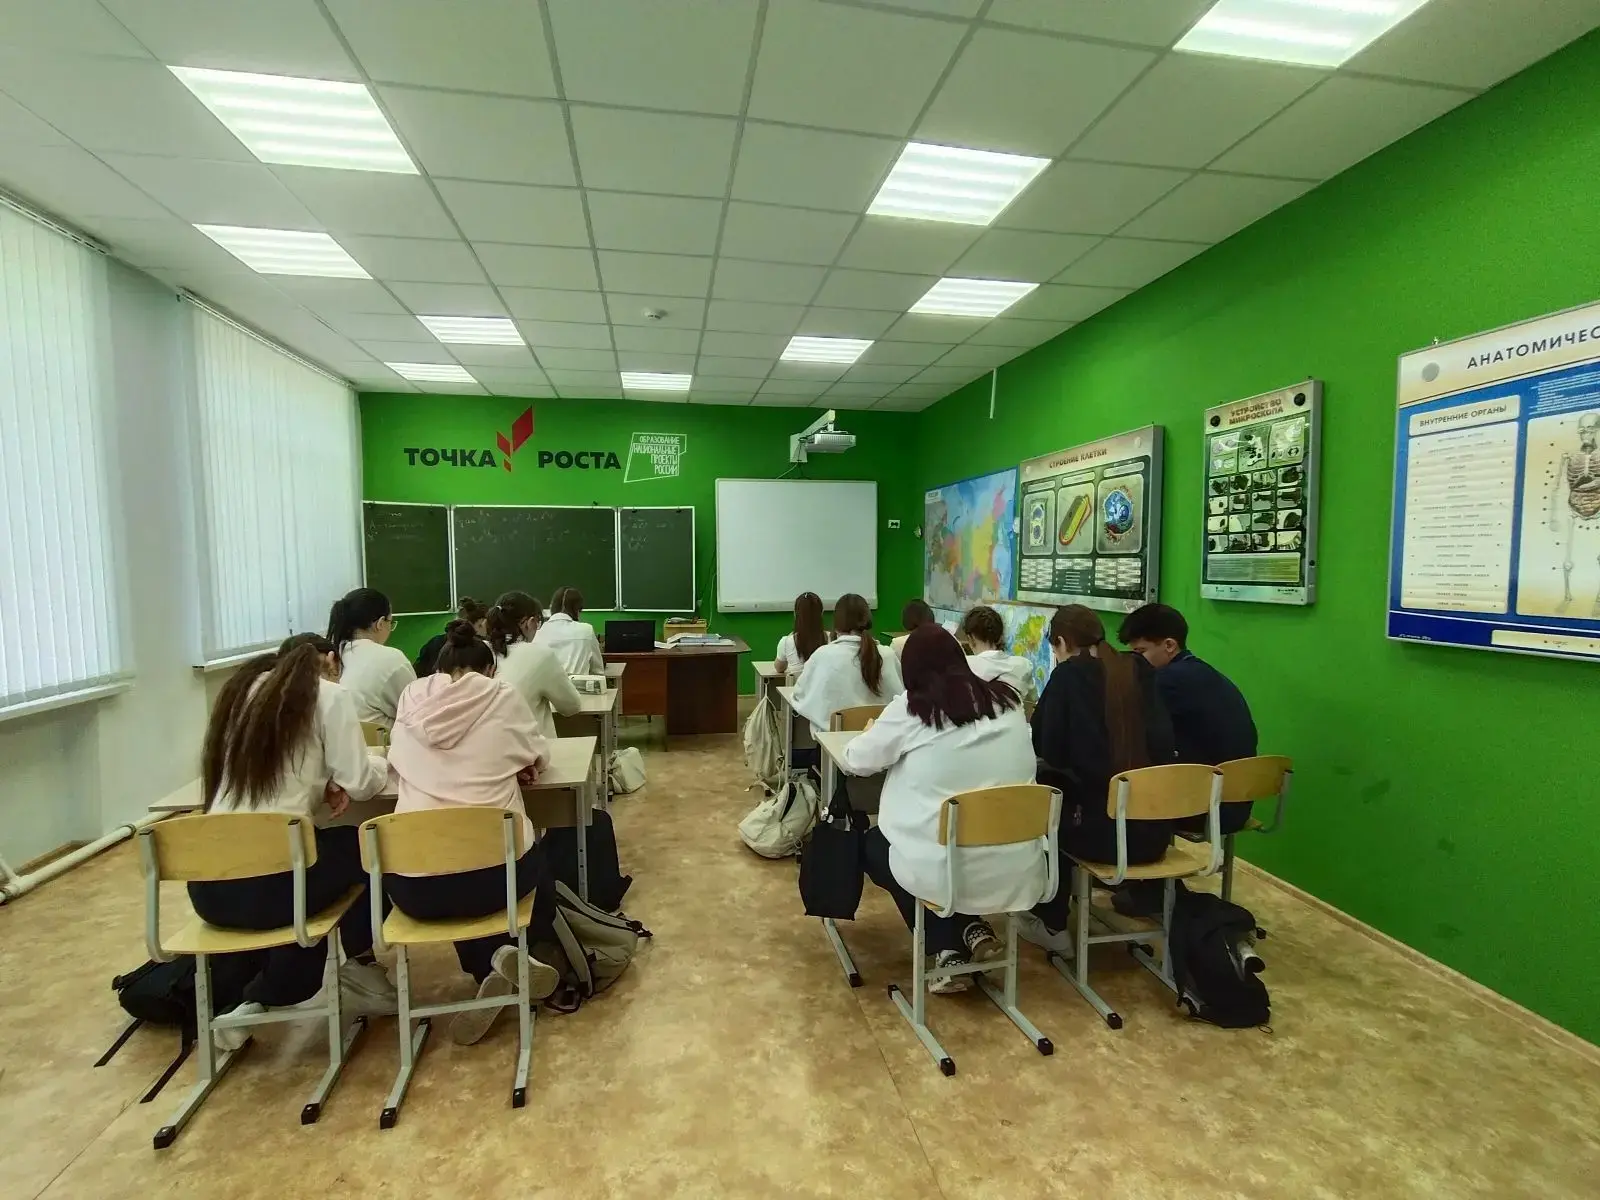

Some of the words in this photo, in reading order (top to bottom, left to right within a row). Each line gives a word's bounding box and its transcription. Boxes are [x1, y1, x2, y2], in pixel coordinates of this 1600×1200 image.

[1229, 407, 1283, 425] МИКРОСКОПА
[1419, 412, 1468, 427] ВНУТРЕННИЕ
[1470, 404, 1507, 418] ОРГАНЫ
[639, 435, 680, 445] ОБРАЗОВАНИЕ
[633, 444, 678, 455] НАЦИОНАЛЬНЫЕ
[1081, 448, 1107, 462] КЛЕТКИ
[404, 447, 497, 468] ТОЧКА
[537, 450, 622, 470] РОСТА
[650, 454, 678, 465] ПРОЕКТЫ
[654, 464, 678, 475] РОССИИ
